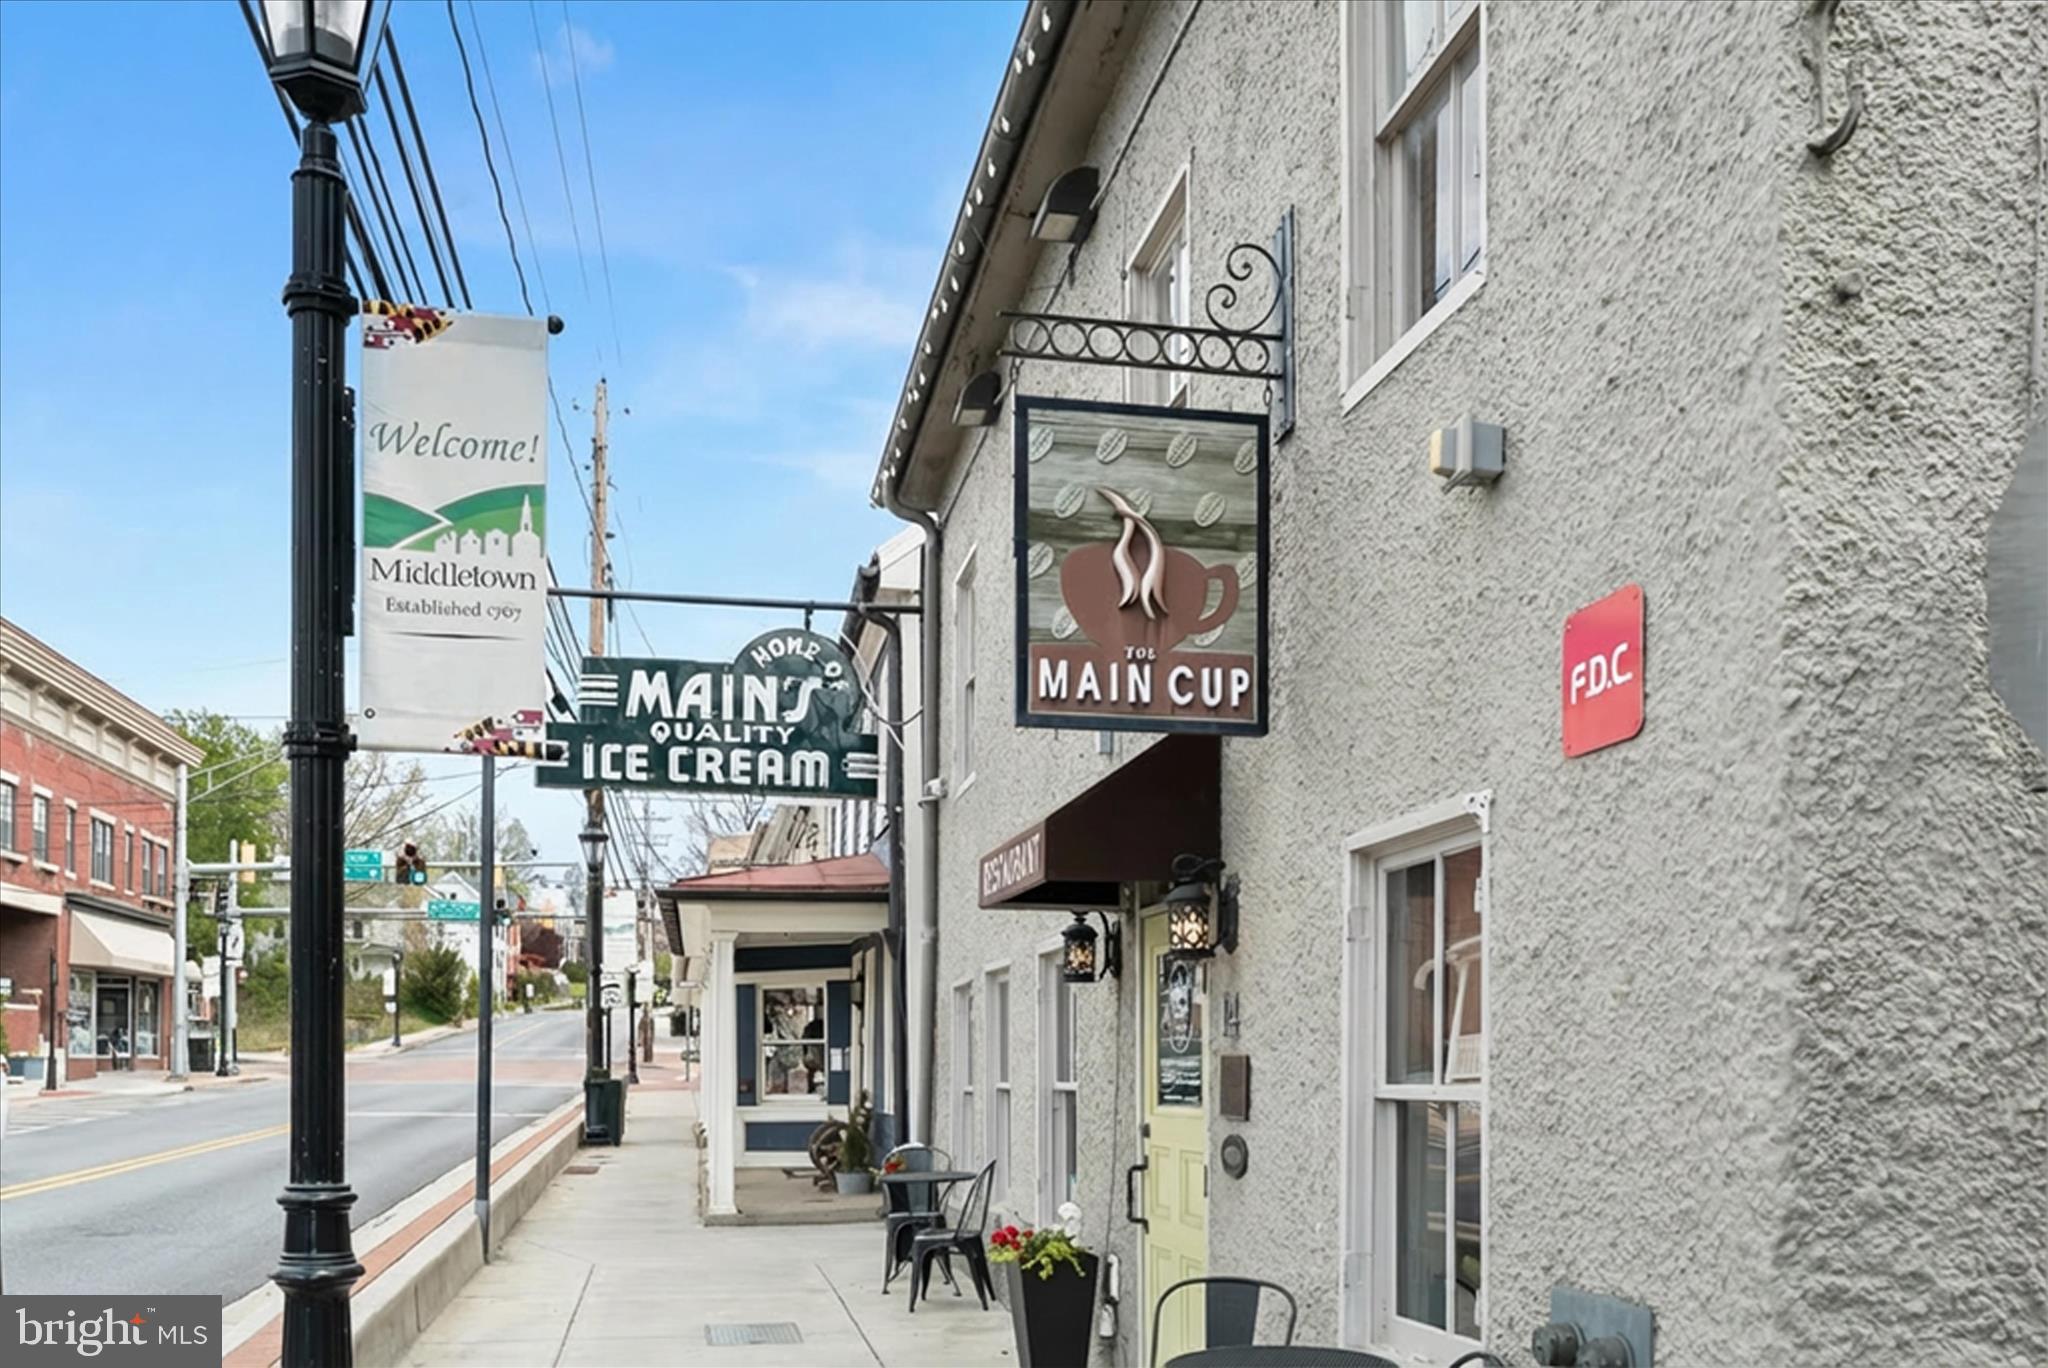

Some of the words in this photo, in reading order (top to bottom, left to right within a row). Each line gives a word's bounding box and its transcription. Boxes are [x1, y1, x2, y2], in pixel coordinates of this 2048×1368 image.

[369, 421, 539, 463] Welcome!
[370, 557, 537, 591] Middletown
[1039, 658, 1151, 704] MAIN
[1167, 664, 1250, 708] CUP
[650, 720, 796, 745] QUALITY
[582, 743, 649, 782] ICE
[667, 746, 830, 788] CREAM
